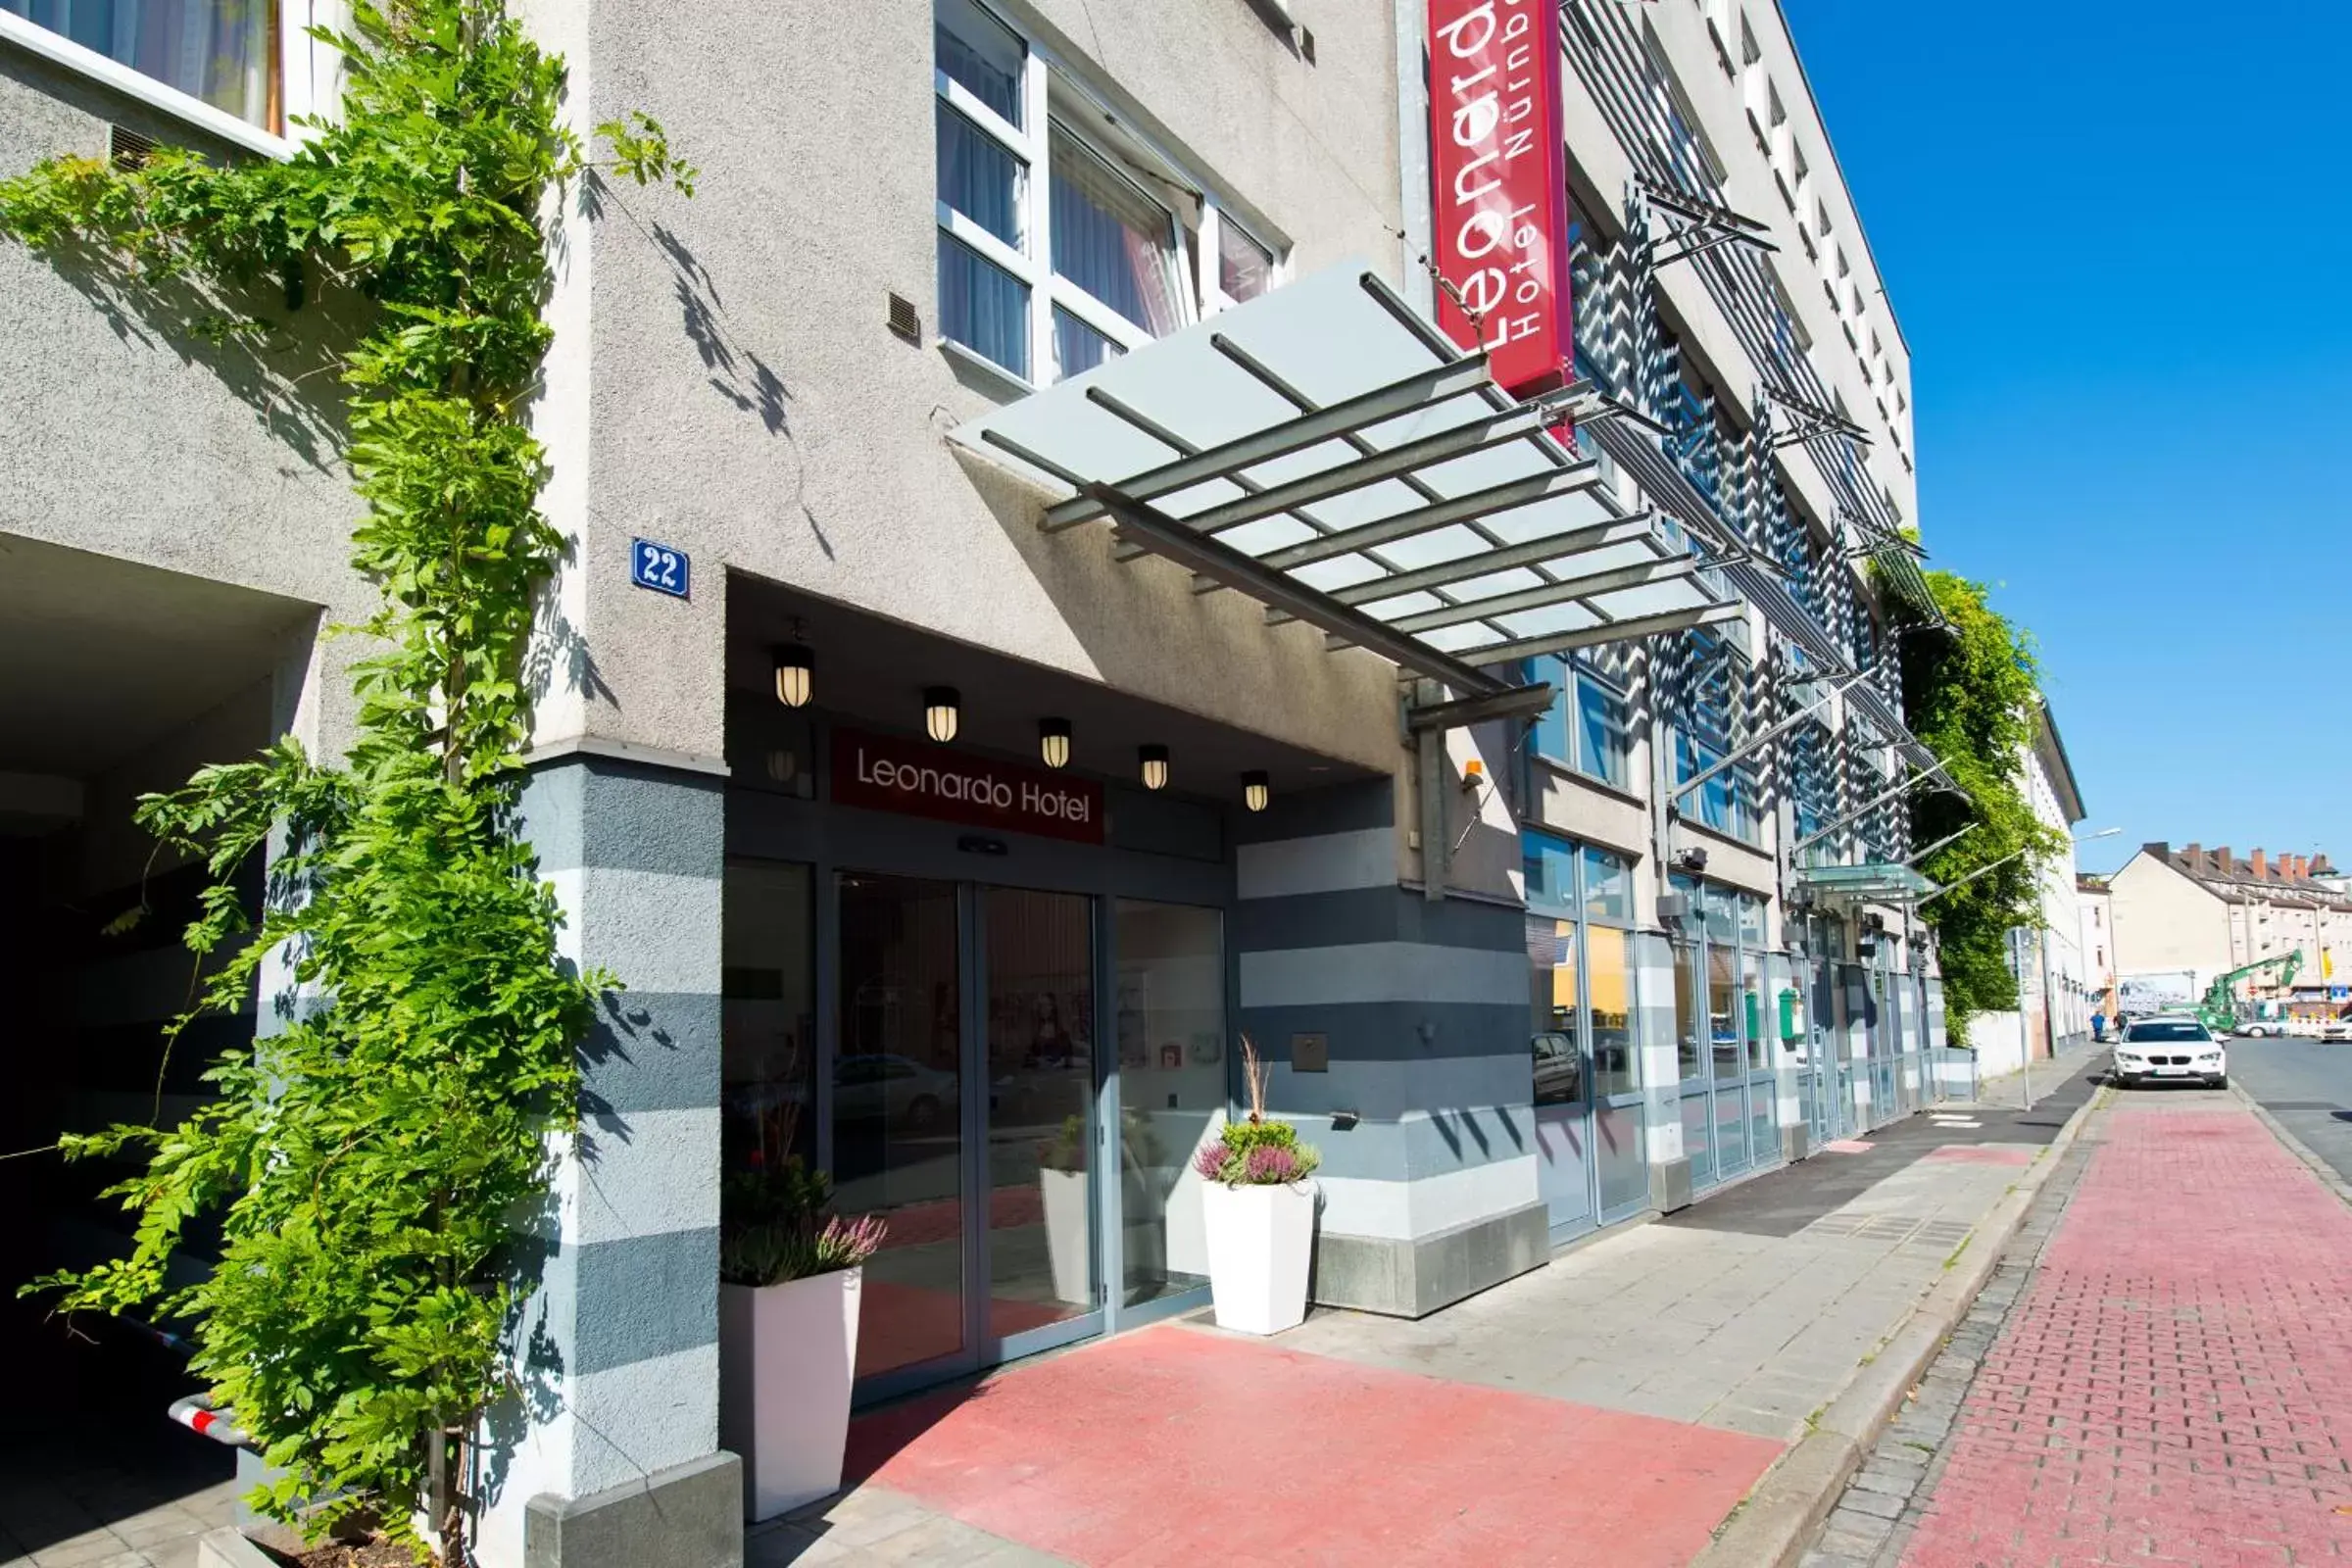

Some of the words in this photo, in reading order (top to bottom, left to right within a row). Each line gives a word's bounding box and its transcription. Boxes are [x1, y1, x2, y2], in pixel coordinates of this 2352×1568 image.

[1500, 0, 1533, 160] Nürnb
[1506, 203, 1541, 341] Hotel
[644, 547, 677, 587] 22
[858, 748, 1012, 808] Leonardo
[1021, 787, 1090, 823] Hotel
